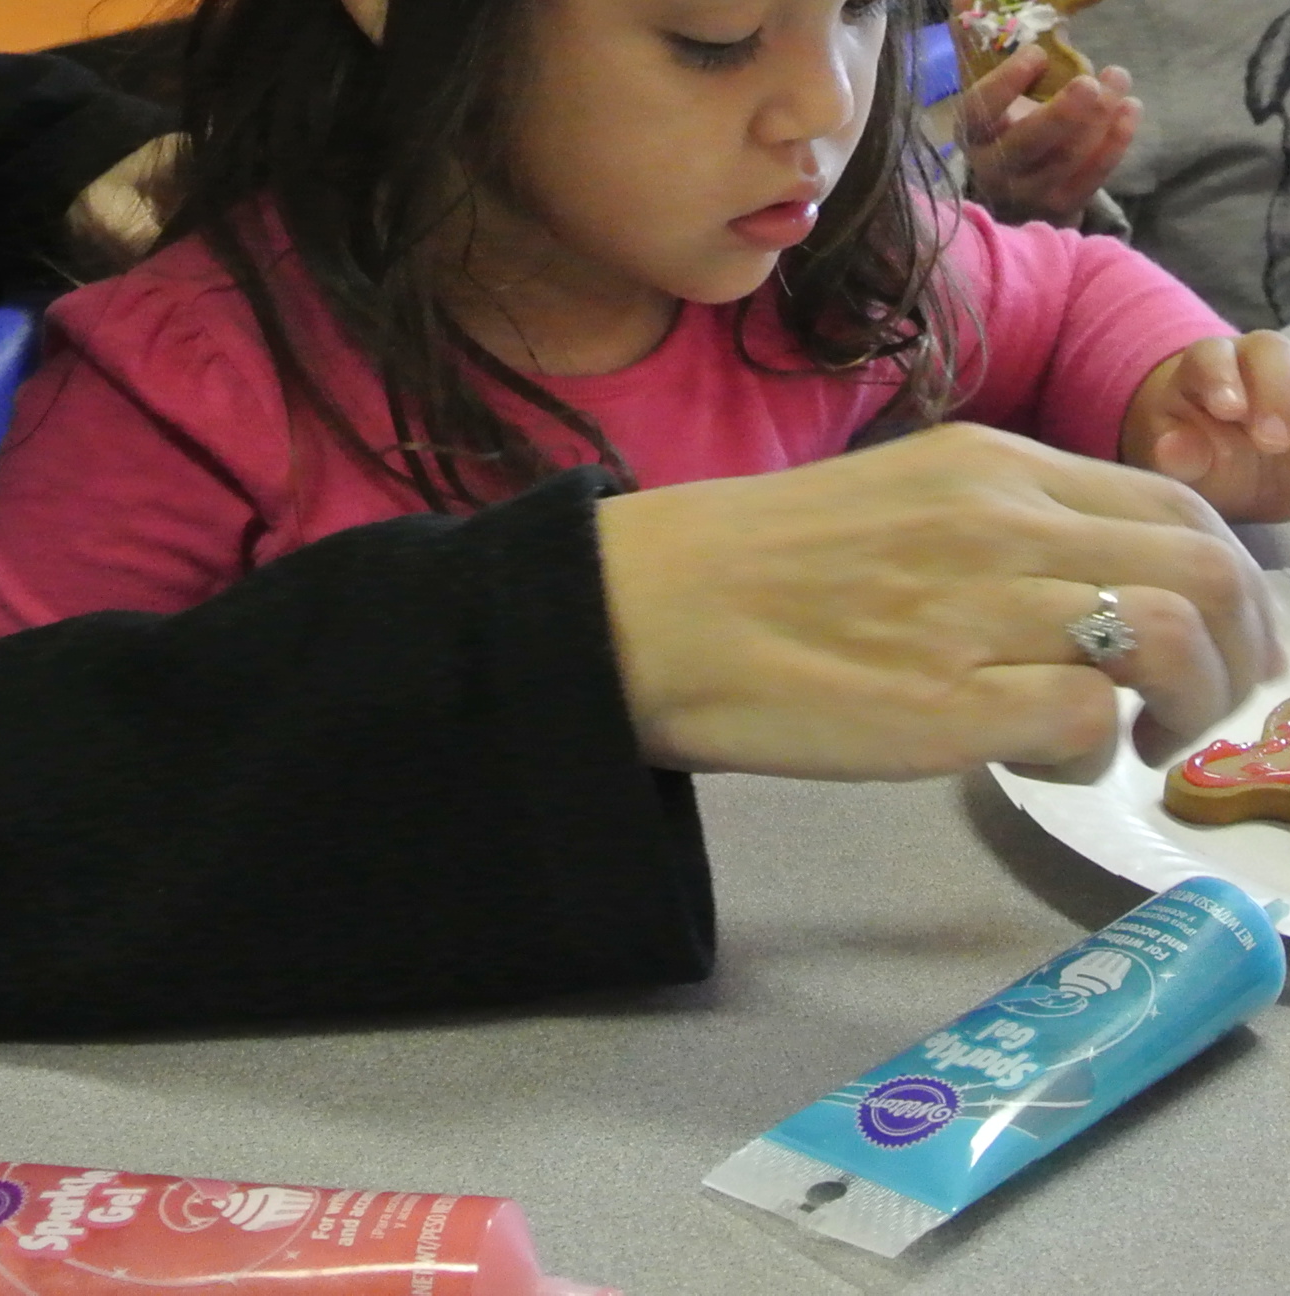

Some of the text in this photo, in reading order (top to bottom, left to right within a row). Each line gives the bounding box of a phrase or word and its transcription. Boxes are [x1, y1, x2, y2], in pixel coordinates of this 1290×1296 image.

[1143, 943, 1171, 961] For
[1156, 933, 1188, 953] and
[974, 1018, 1036, 1050] Gel
[924, 1031, 1039, 1088] Sparkle
[865, 1097, 952, 1123] Wilton
[87, 1188, 148, 1223] Gel
[311, 1216, 336, 1240] For
[338, 1219, 361, 1247] and
